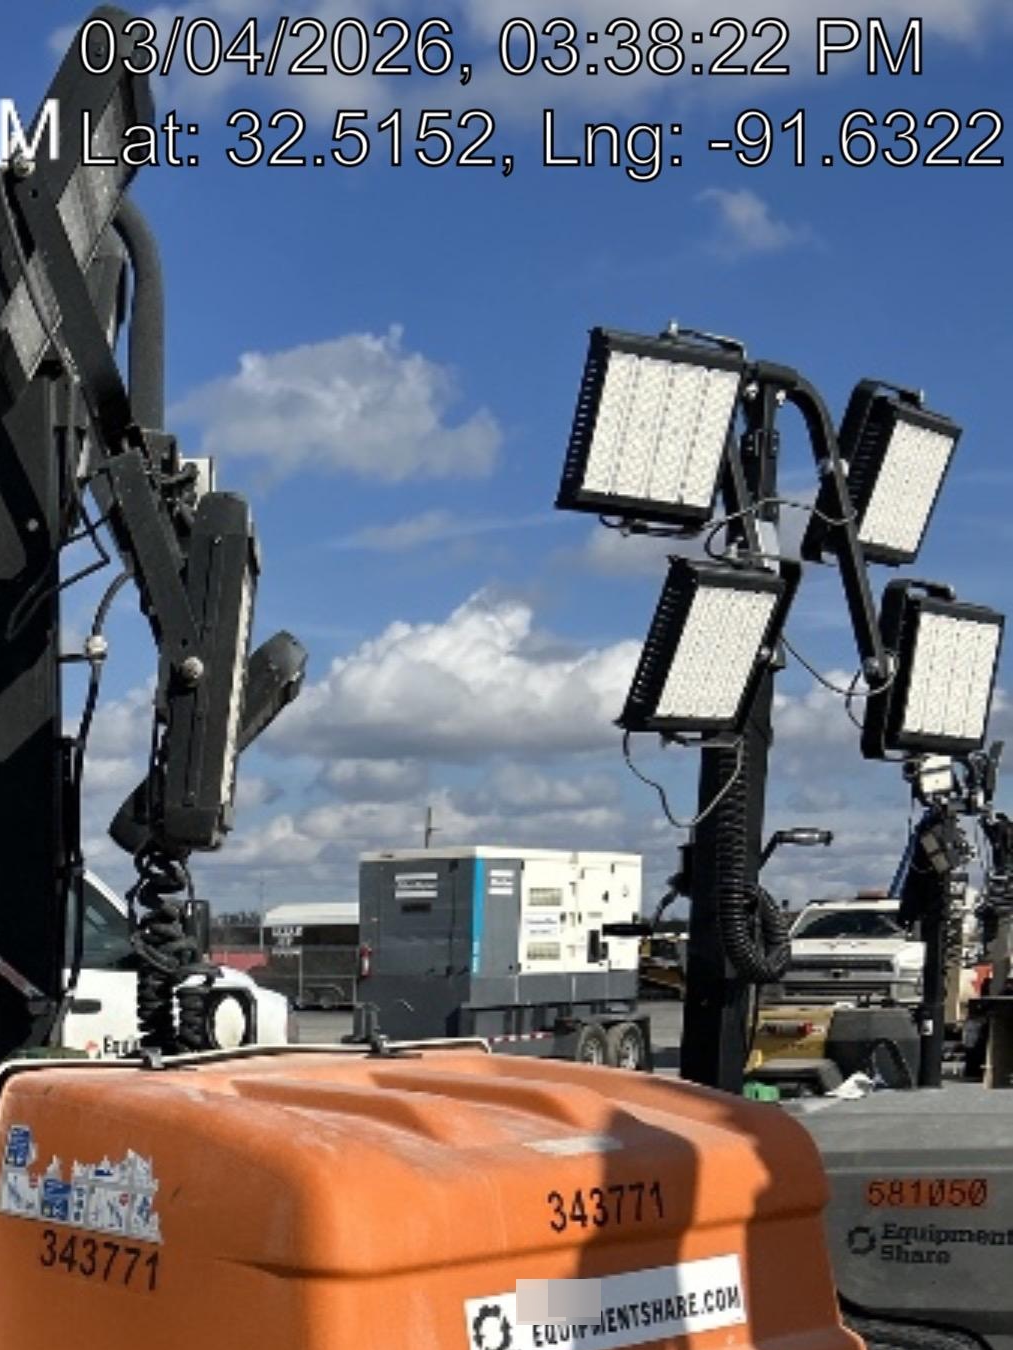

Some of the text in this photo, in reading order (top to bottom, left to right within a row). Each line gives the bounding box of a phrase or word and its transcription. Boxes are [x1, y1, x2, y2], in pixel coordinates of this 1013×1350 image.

[547, 1181, 664, 1233] 343771
[868, 1179, 987, 1206] 581050
[41, 1229, 159, 1291] 343771
[881, 1244, 950, 1264] Share
